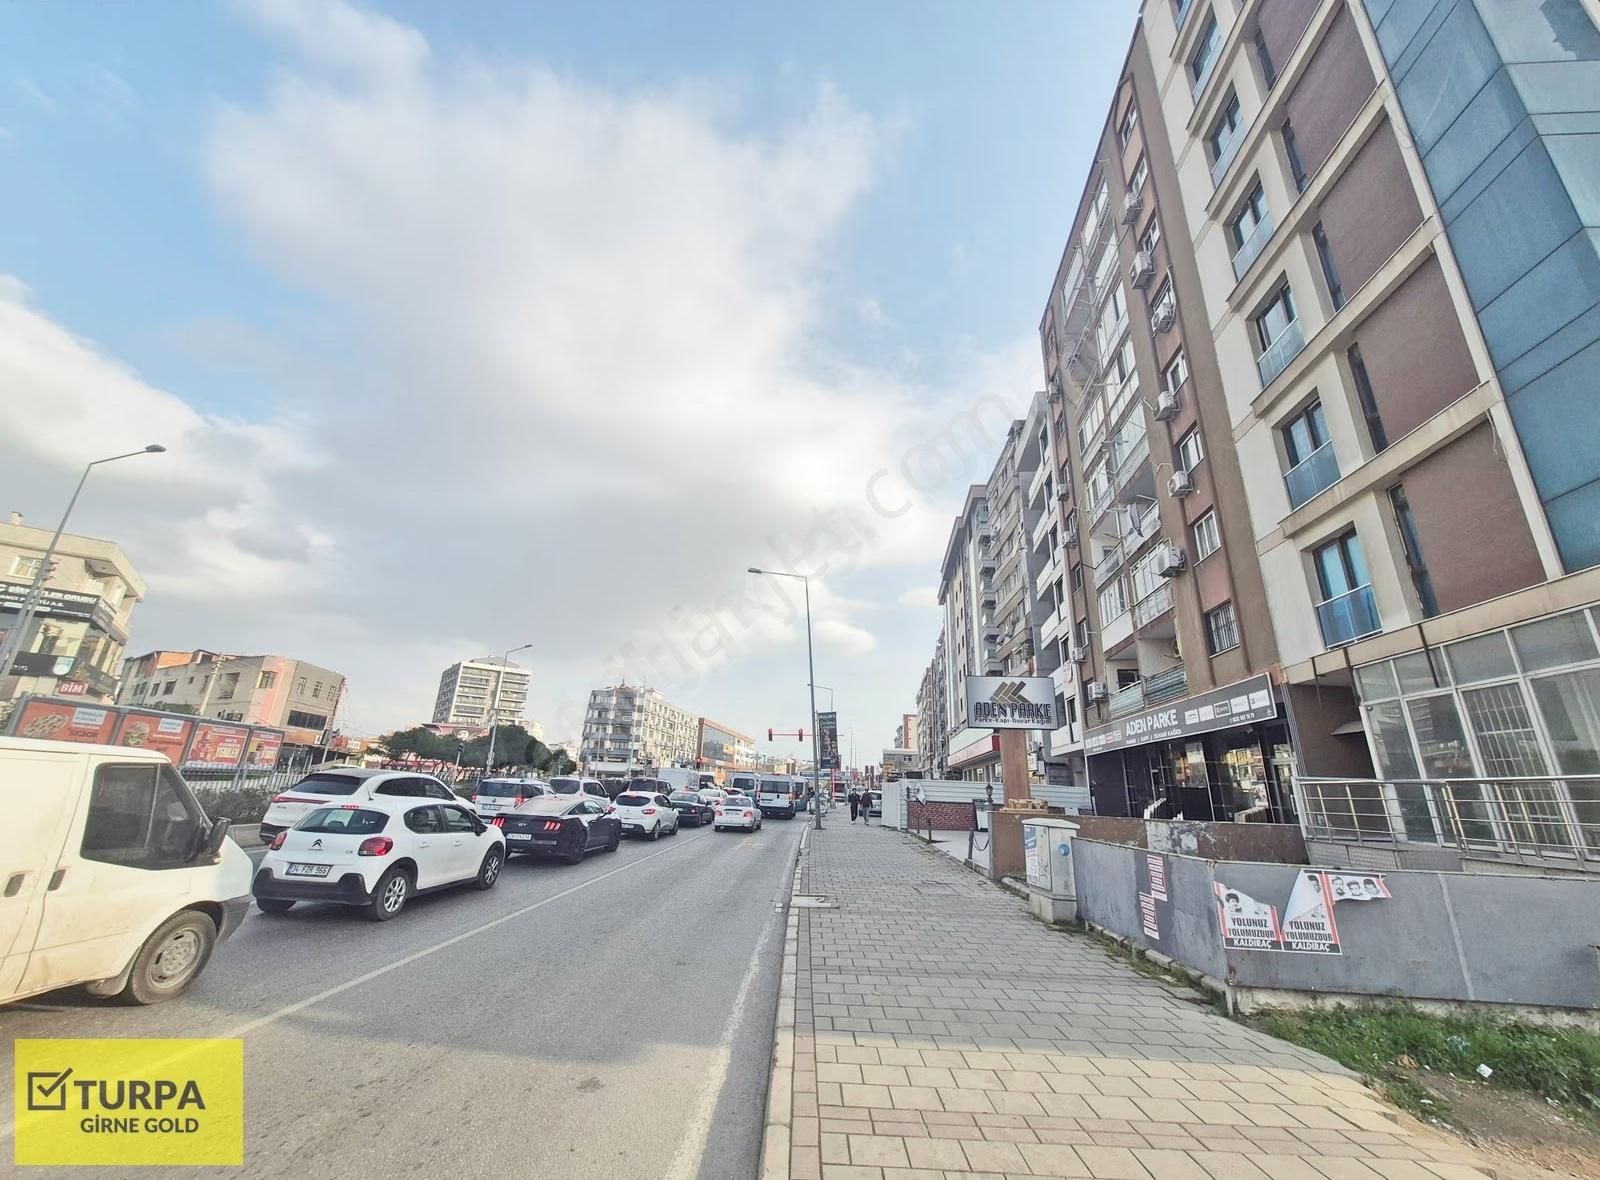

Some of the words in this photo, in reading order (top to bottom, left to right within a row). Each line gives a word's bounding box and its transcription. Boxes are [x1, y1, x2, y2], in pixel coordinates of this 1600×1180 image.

[60, 682, 83, 693] BİM
[974, 702, 1007, 718] ADEN
[1010, 703, 1052, 719] PARKE
[1126, 717, 1147, 737] ADEN
[1147, 709, 1179, 732] PARKE
[1231, 917, 1268, 928] YOLUNUZ
[1288, 920, 1326, 931] YOLUNUZ
[1228, 928, 1275, 939] YOLUMUZDUR
[1286, 931, 1333, 942] YOLUMUZDUR
[1233, 938, 1272, 948] KALDIRAÇ
[1291, 942, 1330, 951] KALDIRAÇ
